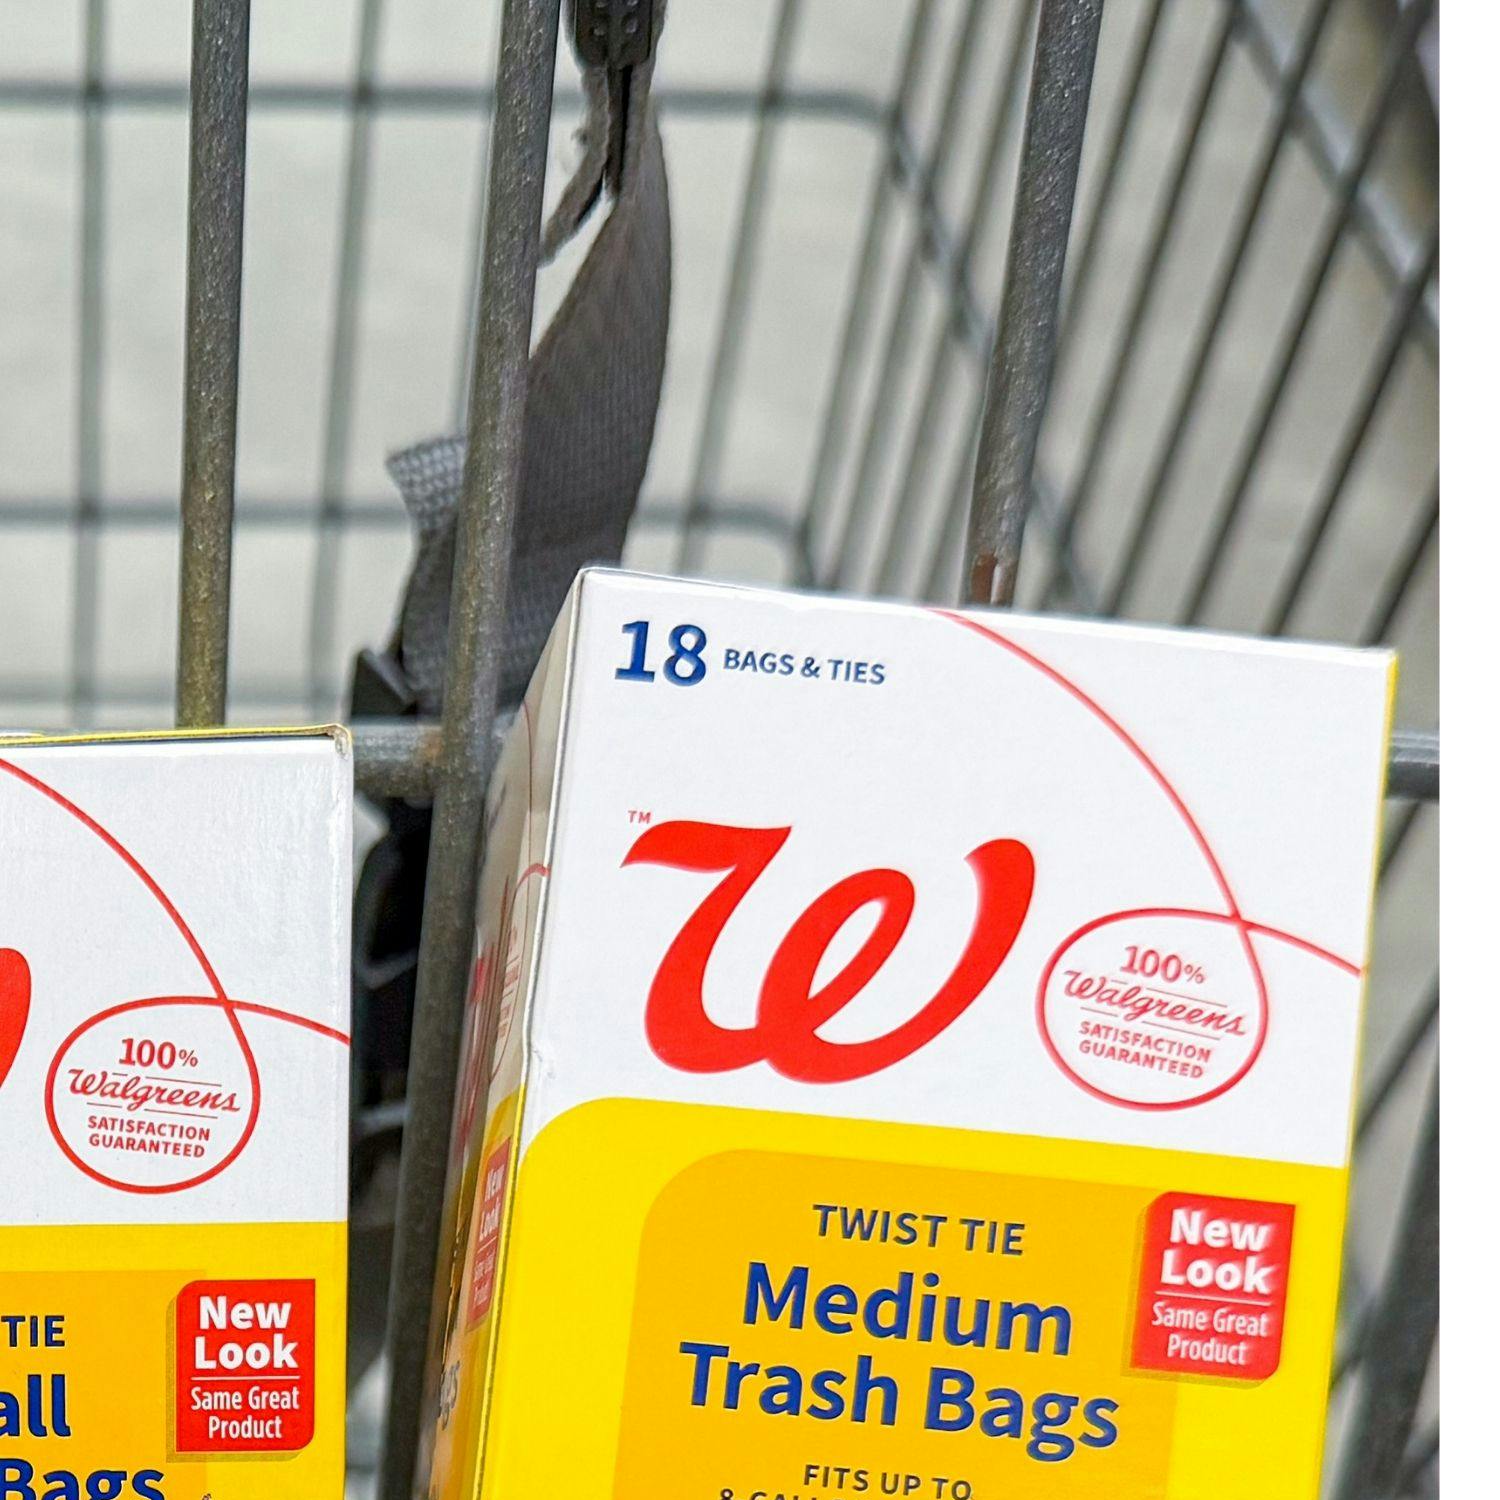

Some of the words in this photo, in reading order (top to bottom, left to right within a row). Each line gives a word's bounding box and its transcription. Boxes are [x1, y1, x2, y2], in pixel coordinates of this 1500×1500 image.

[615, 620, 706, 686] 18
[724, 648, 793, 677] BAGS
[829, 659, 885, 684] TIES
[1120, 946, 1204, 984] 100%
[1065, 970, 1248, 1037] Walgreens
[119, 1038, 198, 1069] 100%
[1079, 1020, 1212, 1062] SATISFACTION
[1079, 1040, 1203, 1079] GUARANTEED
[68, 1068, 240, 1113] Walgreens
[88, 1117, 210, 1141] SATISFACTION
[89, 1134, 205, 1158] GUARANTEED
[812, 1205, 947, 1248] TWIST
[960, 1217, 1025, 1255] TIE
[1170, 1209, 1268, 1251] New
[1161, 1248, 1271, 1295] Look
[200, 1295, 290, 1329] New
[742, 1261, 1070, 1355] Medium
[1152, 1301, 1206, 1330] Same
[1212, 1307, 1268, 1337] Great
[2, 1316, 64, 1347] TIE
[194, 1333, 298, 1370] Look
[1166, 1335, 1246, 1366] Product
[191, 1386, 242, 1412] Same
[248, 1386, 299, 1410] Great
[679, 1342, 897, 1427] Trash
[924, 1367, 1120, 1462] Bags
[208, 1415, 281, 1439] Product
[803, 1464, 868, 1493] FITS
